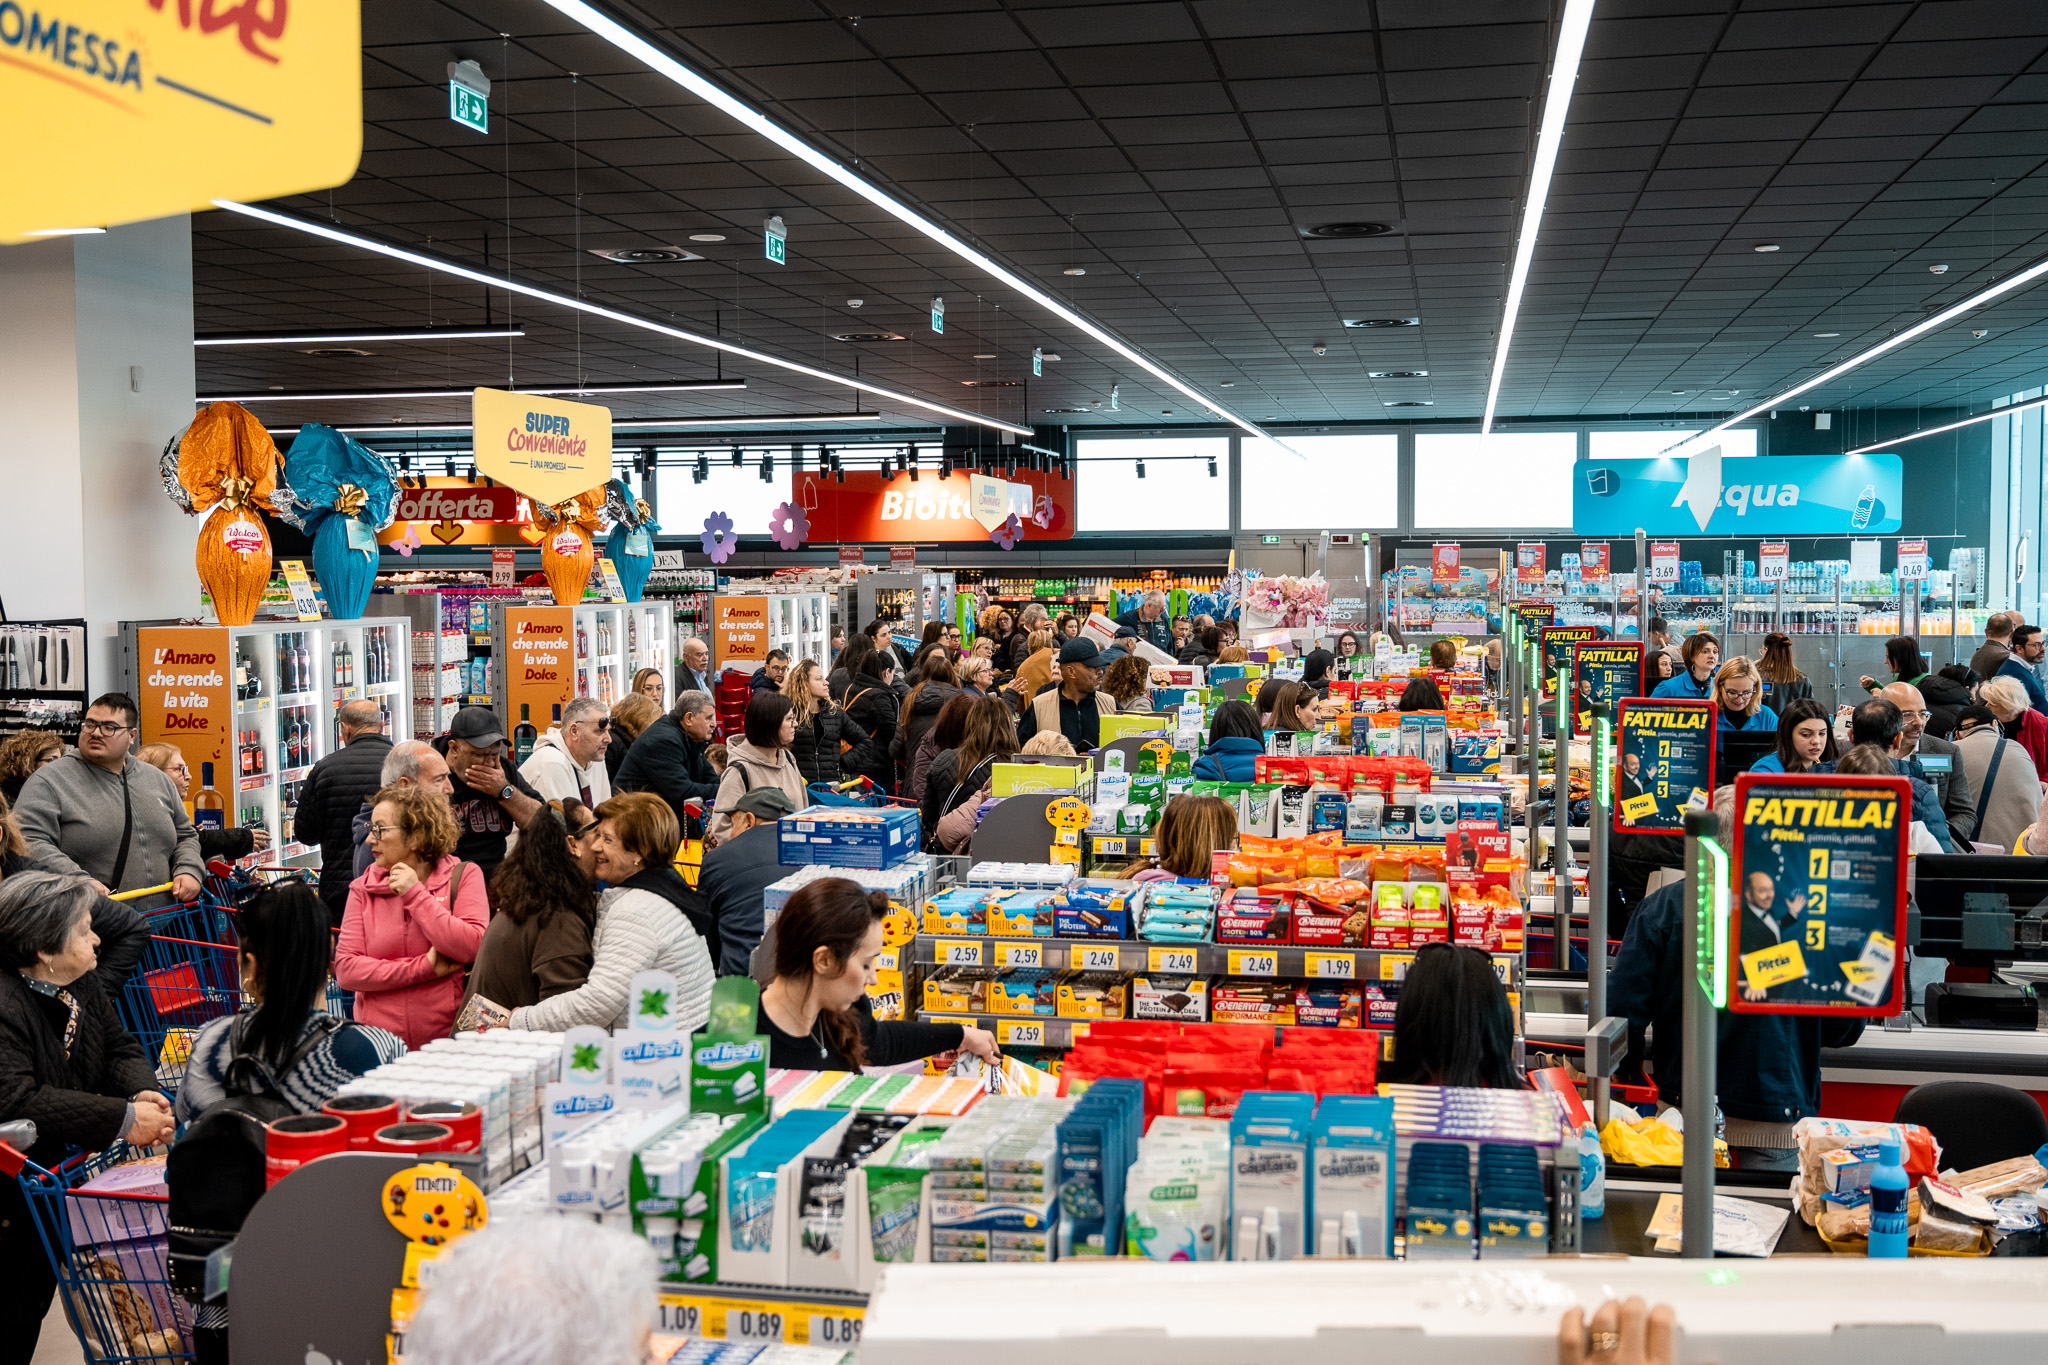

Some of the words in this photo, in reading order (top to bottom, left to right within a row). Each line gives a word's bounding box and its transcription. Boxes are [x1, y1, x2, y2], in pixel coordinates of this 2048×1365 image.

[525, 412, 569, 436] SUPER
[507, 427, 587, 457] Conveniente
[544, 461, 566, 470] PROMESSA
[400, 491, 494, 519] offerta
[227, 527, 259, 538] Walcor
[1903, 565, 1921, 576] 0,49
[723, 607, 760, 618] L'Amaro
[516, 622, 563, 634] L'Amaro
[719, 621, 735, 629] che
[736, 621, 764, 630] rende
[729, 632, 737, 642] la
[738, 633, 755, 642] vita
[1545, 632, 1591, 640] FATTILLA!
[512, 638, 531, 650] che
[533, 639, 569, 650] rende
[729, 644, 756, 654] Dolce
[153, 648, 216, 665] L'Amaro
[524, 654, 534, 665] la
[536, 655, 557, 665] vita
[1578, 651, 1638, 662] FATTILLA!
[148, 671, 175, 687] che
[177, 671, 223, 687] rende
[524, 668, 557, 680] Dolce
[1606, 672, 1611, 682] 1
[1605, 687, 1611, 696] 2
[164, 691, 177, 708] la
[179, 691, 208, 708] vita
[165, 713, 209, 729] Dolce
[1623, 712, 1708, 729] FATTILLA!
[1661, 745, 1667, 756] 1
[1659, 765, 1667, 776] 2
[1658, 785, 1665, 796] 3
[1630, 800, 1649, 811] Pittia
[1743, 798, 1898, 830] FATTILLA!
[1478, 836, 1507, 846] LIQUID
[1813, 856, 1822, 875] 1
[1809, 891, 1824, 912] 2
[926, 919, 945, 929] FULFIL
[992, 920, 1010, 930] FULFIL
[1233, 919, 1265, 928] ENERVIT
[1310, 917, 1342, 926] ENERVIT
[1806, 927, 1820, 946] 3
[955, 947, 978, 961] 2,59
[1015, 949, 1038, 963] 2,59
[1091, 952, 1114, 967] 2,49
[1169, 955, 1193, 969] 2,49
[1248, 957, 1273, 972] 2,49
[1326, 960, 1350, 975] 1,99
[1757, 956, 1790, 974] Pittia
[927, 997, 946, 1007] FULFIL
[993, 999, 1012, 1009] FULFIL
[1060, 1002, 1079, 1012] FULFIL
[1227, 1001, 1260, 1011] ENERVIT
[1216, 1012, 1272, 1021] PERFORMANCE
[1309, 1008, 1339, 1016] ENERVIT
[1017, 1027, 1039, 1041] 2,59
[1151, 1185, 1198, 1199] GUM
